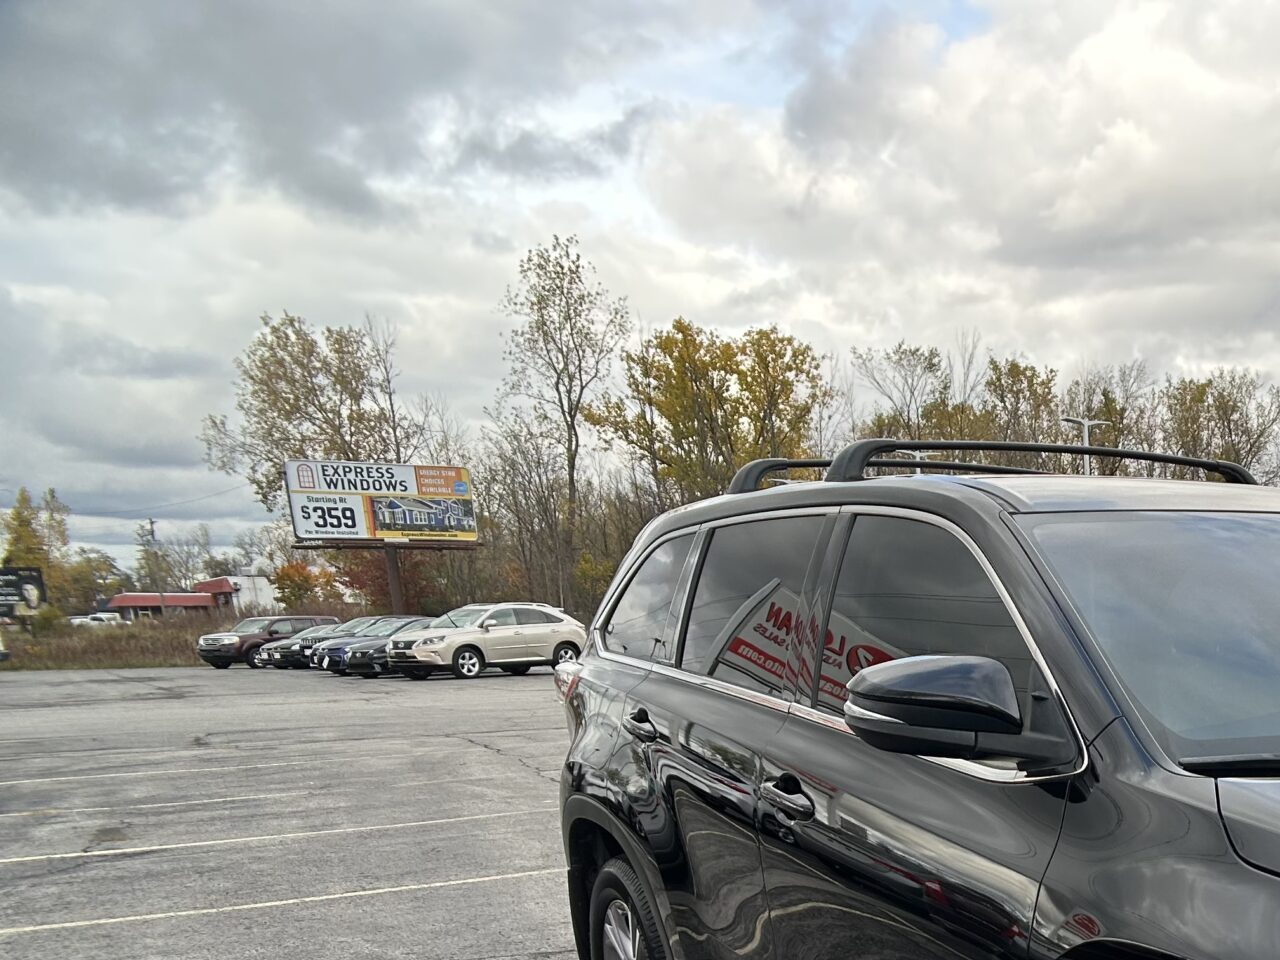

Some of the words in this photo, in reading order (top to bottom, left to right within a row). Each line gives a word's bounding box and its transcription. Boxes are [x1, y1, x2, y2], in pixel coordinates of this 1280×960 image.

[321, 464, 395, 480] EXPRESS
[323, 477, 408, 492] WINDOWS
[306, 495, 338, 504] Starting
[300, 505, 357, 529] $359
